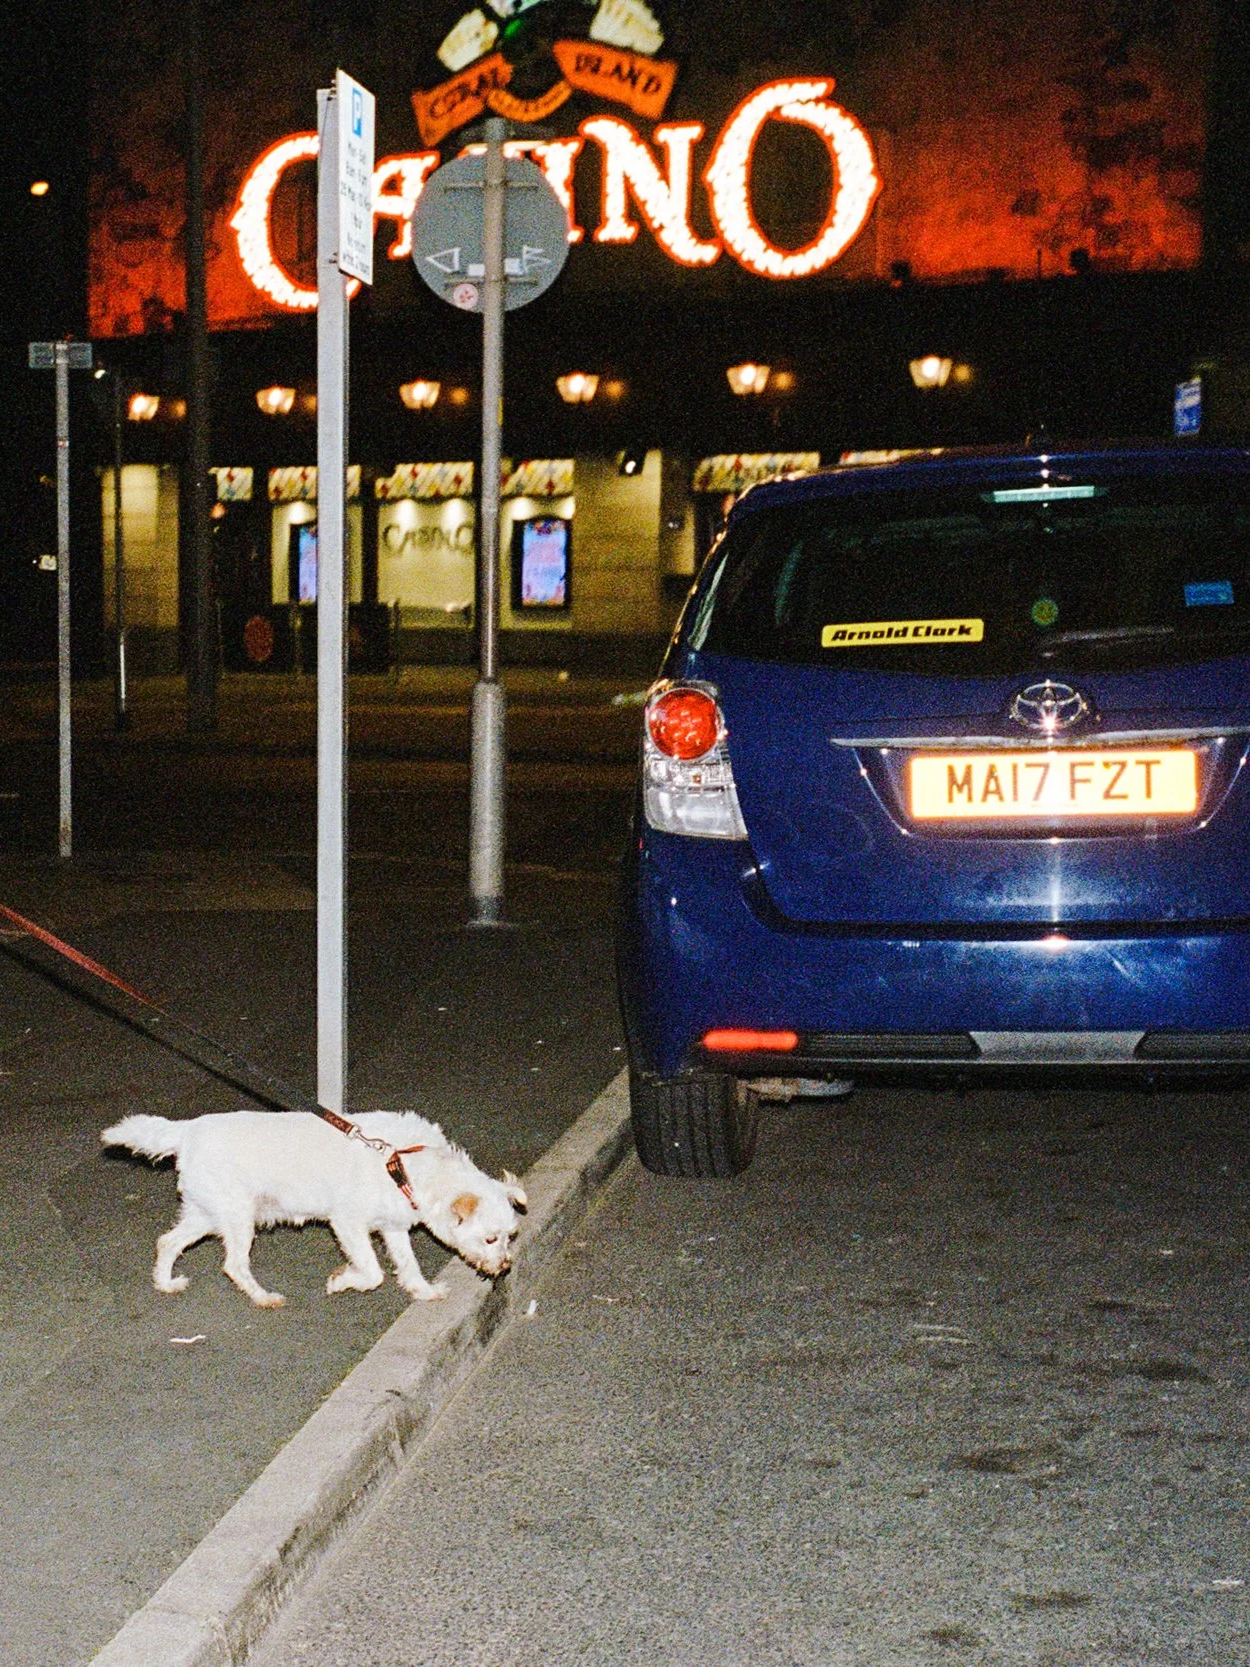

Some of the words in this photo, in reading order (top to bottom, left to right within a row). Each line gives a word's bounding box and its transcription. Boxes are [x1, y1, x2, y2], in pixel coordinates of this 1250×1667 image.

[574, 53, 661, 95] ISLAND
[831, 627, 909, 642] Arnold
[912, 625, 972, 638] Clark
[947, 762, 1050, 803] MA17
[1068, 759, 1161, 801] FZT
